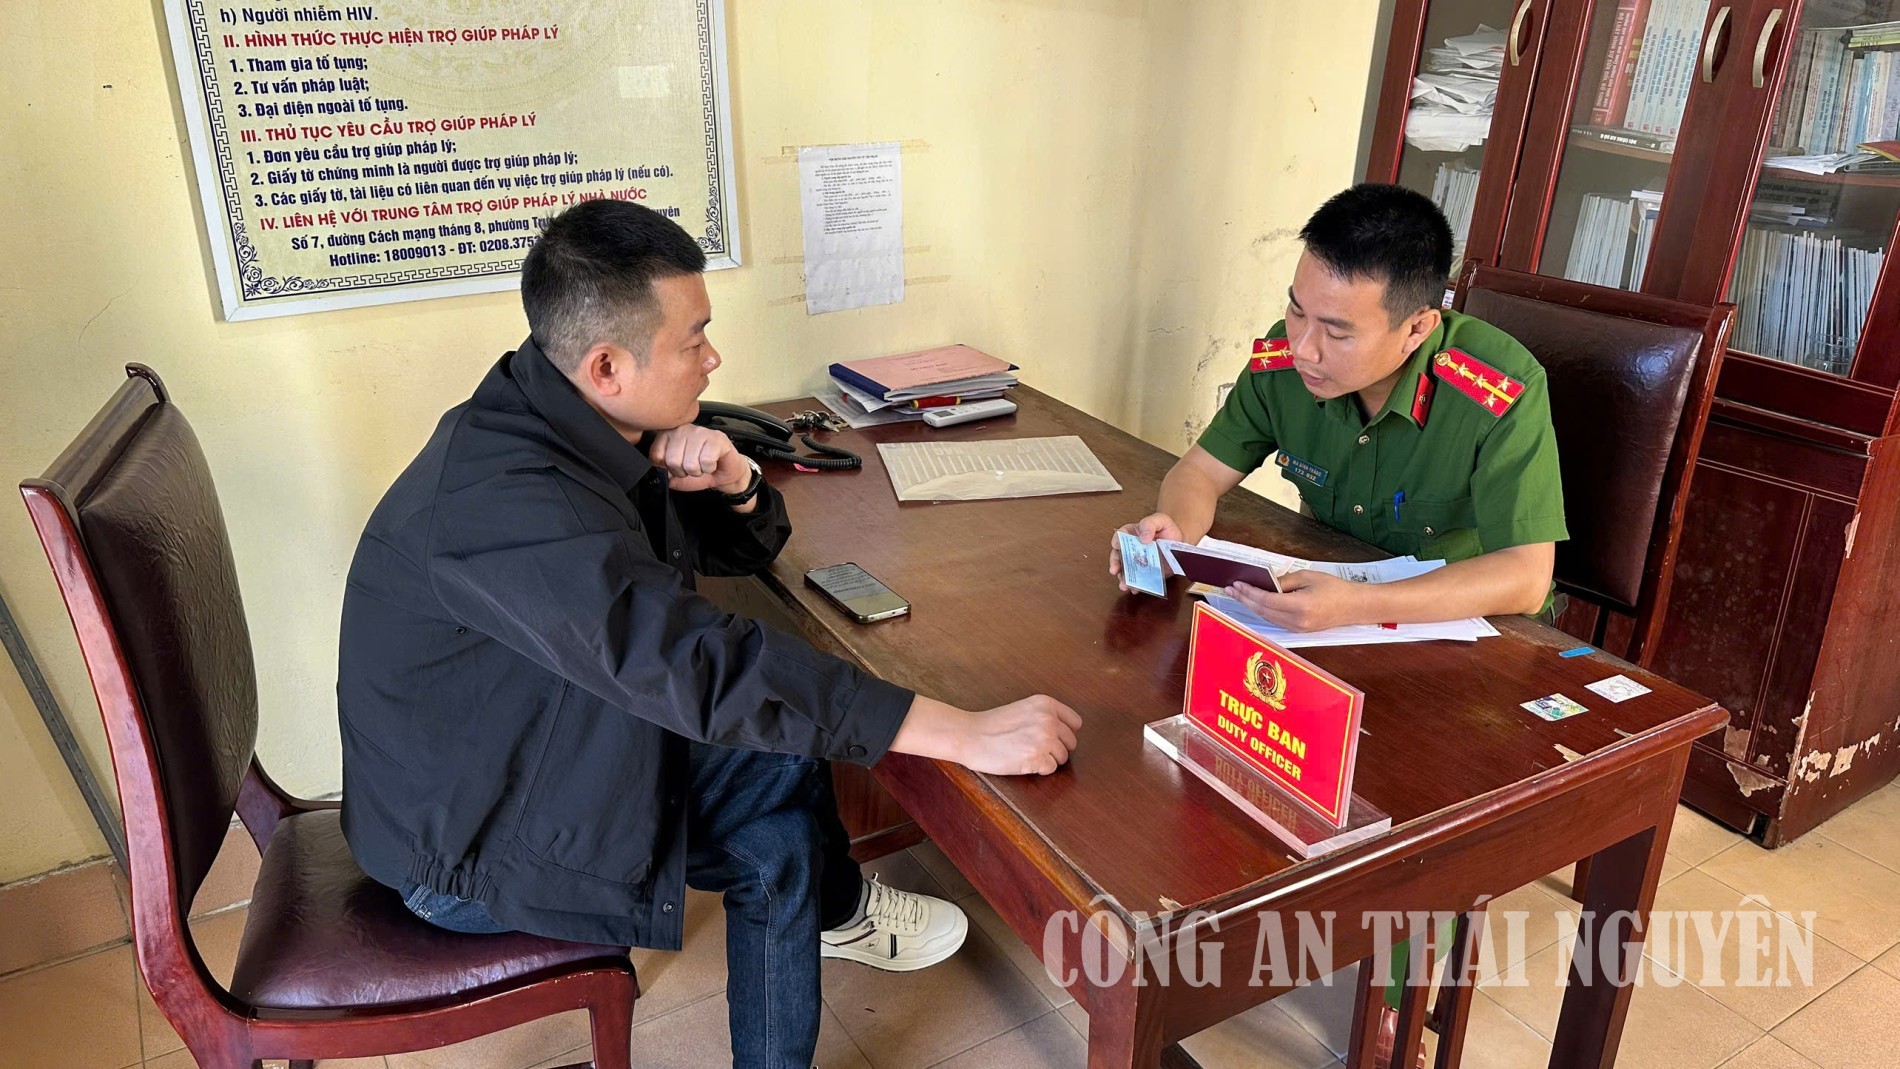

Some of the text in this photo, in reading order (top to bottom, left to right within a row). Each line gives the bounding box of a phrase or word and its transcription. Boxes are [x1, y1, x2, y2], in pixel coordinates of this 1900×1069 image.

[219, 5, 378, 26] h) Người nhiễm HIV.
[223, 24, 559, 48] II. HÌNH THỨC THỰC HIỆN TRỢ GIÚP PHÁP LÝ
[229, 54, 368, 73] 1. Tham gia tố tụng;
[233, 76, 370, 95] 2. Tư vấn pháp luật;
[237, 95, 408, 119] 3. Đại diện ngoài tố tụng.
[240, 111, 536, 143] III. THỦ TỤC YÊU CẦU TRỢ GIÚP PHÁP LÝ
[246, 138, 457, 165] 1. Đơn yêu cầu trợ giúp pháp lý;
[250, 151, 578, 186] 2. Giấy tờ chứng minh là người được trợ giúp pháp lý;
[254, 164, 674, 207] 3. Các giấy tờ, tài liệu có liên quan đến vụ việc trợ giúp pháp lý (nếu có).
[260, 186, 647, 231] IV. LIÊN HỆ VỚI TRUNG TÂM TRỢ GIÚP PHÁP LÝ NHÀ NƯỚC
[291, 234, 308, 250] Số
[310, 236, 324, 250] 7,
[327, 232, 366, 247] đường
[368, 229, 400, 244] Cách
[402, 228, 436, 242] mạng
[438, 223, 472, 237] tháng
[474, 221, 486, 235] 8,
[488, 218, 530, 234] phường
[329, 252, 381, 267] Hotline:
[383, 244, 446, 262] 18009013
[457, 241, 477, 255] ĐT:
[479, 236, 537, 253] 0208.375
[1219, 689, 1306, 760] TRỰC BAN
[1217, 714, 1302, 781] DUTY OFFICER
